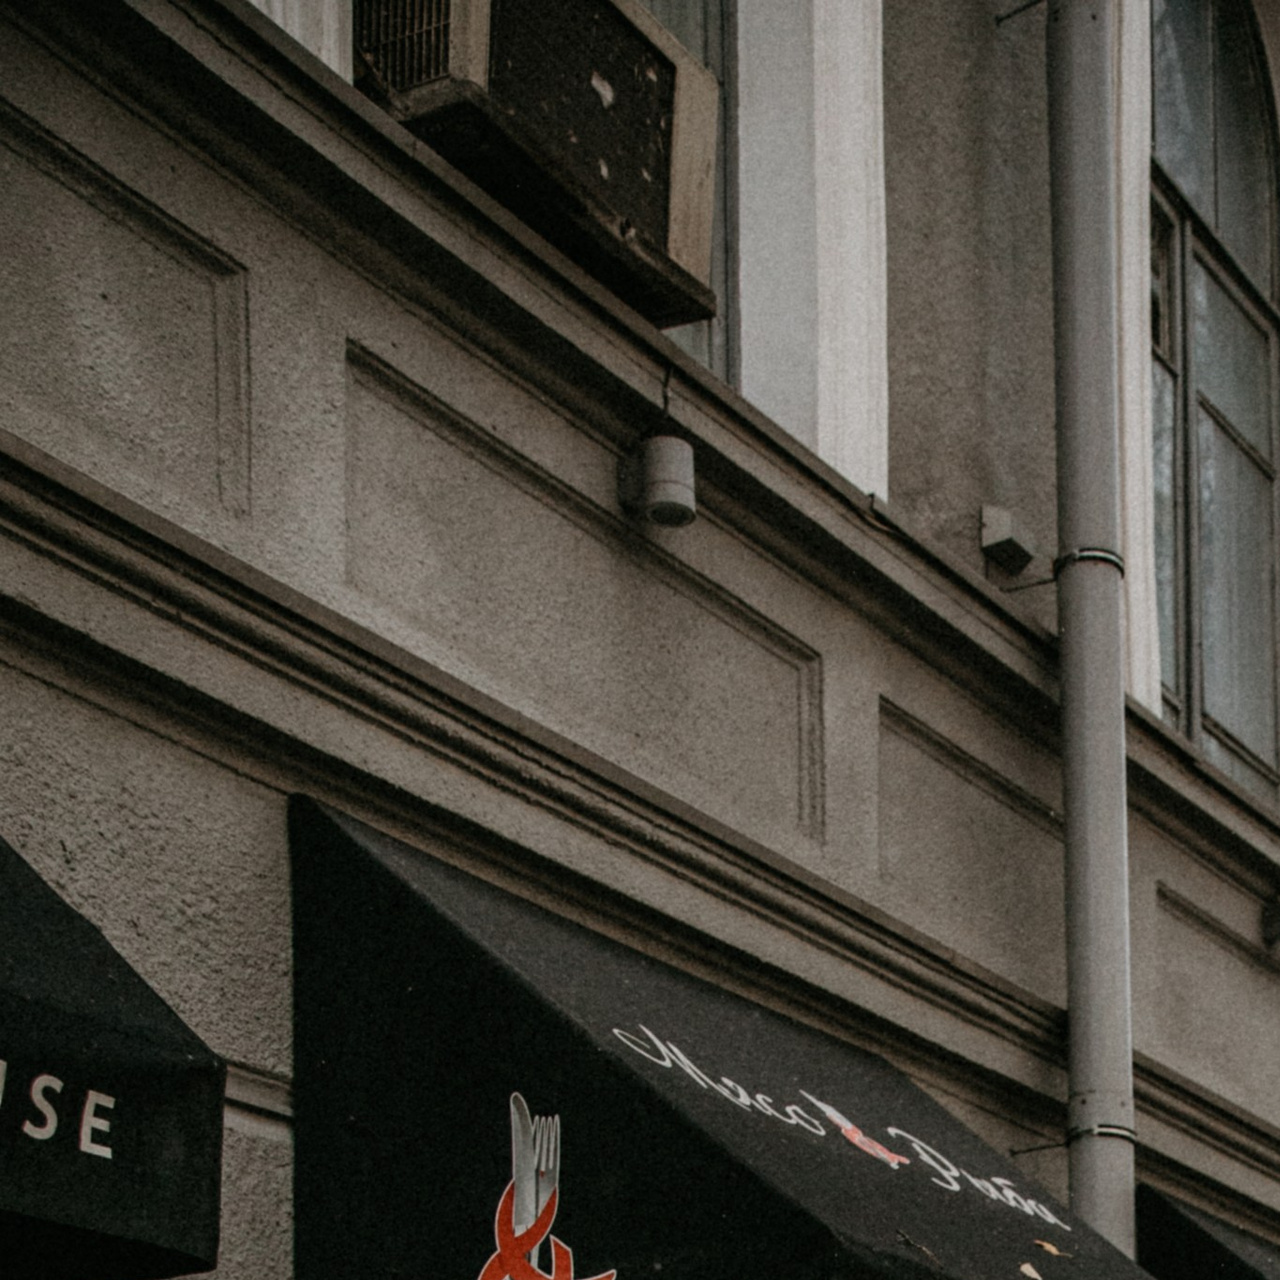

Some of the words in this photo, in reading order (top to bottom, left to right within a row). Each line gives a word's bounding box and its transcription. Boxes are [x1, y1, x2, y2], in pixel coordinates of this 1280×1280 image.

[0, 1058, 116, 1160] SE
[611, 1024, 826, 1136] Мясо
[887, 1126, 1071, 1231] Рыба
